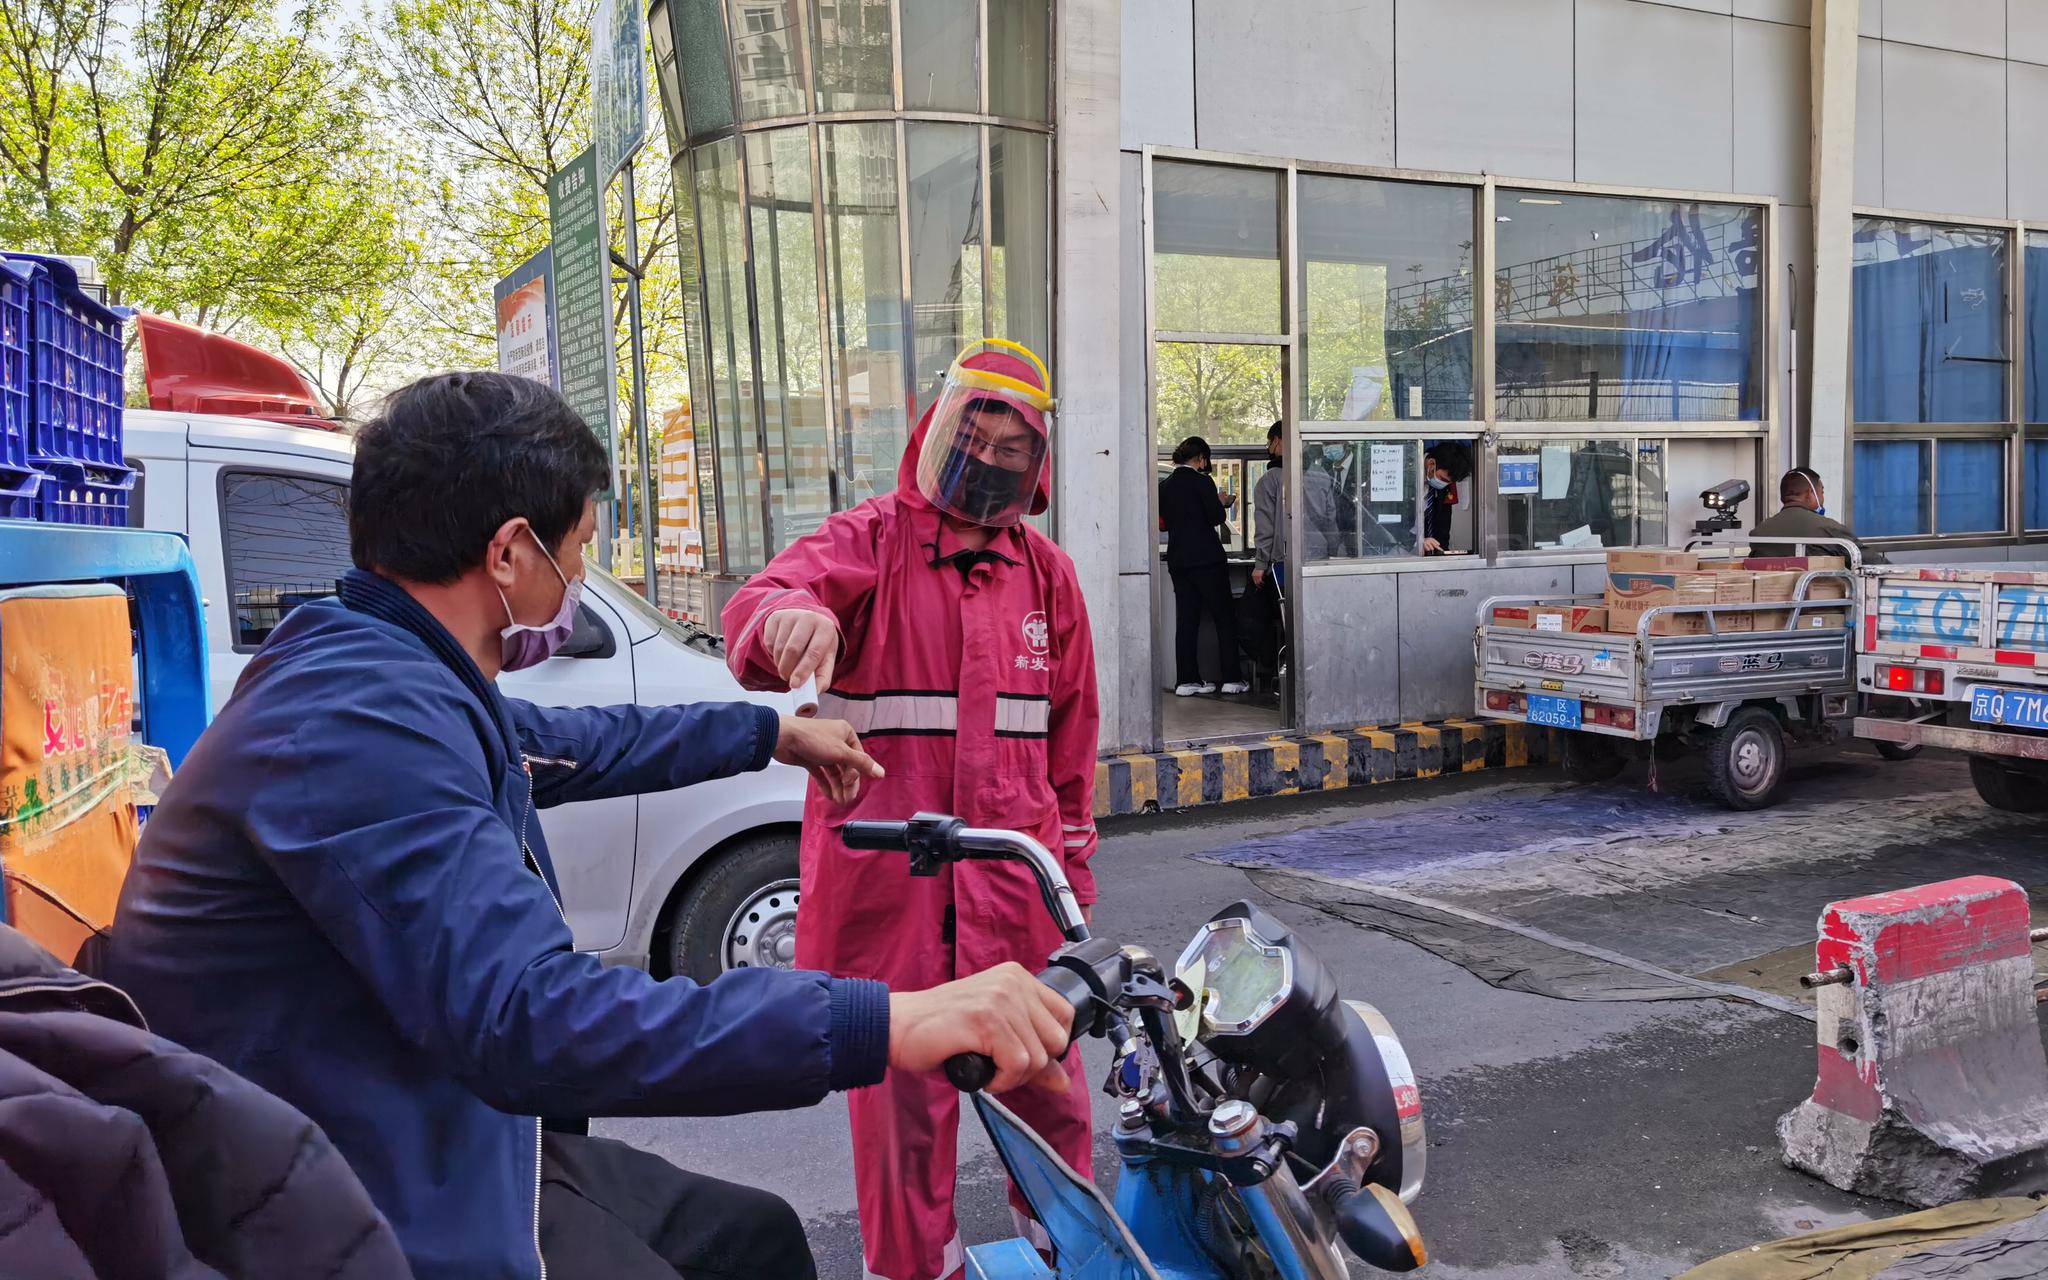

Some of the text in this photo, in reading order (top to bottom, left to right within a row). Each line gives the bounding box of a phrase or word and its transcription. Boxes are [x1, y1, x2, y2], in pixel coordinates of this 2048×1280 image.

[558, 167, 586, 200] 收费告知
[1014, 655, 1049, 672] 新发
[1741, 652, 1784, 672] 蓝马
